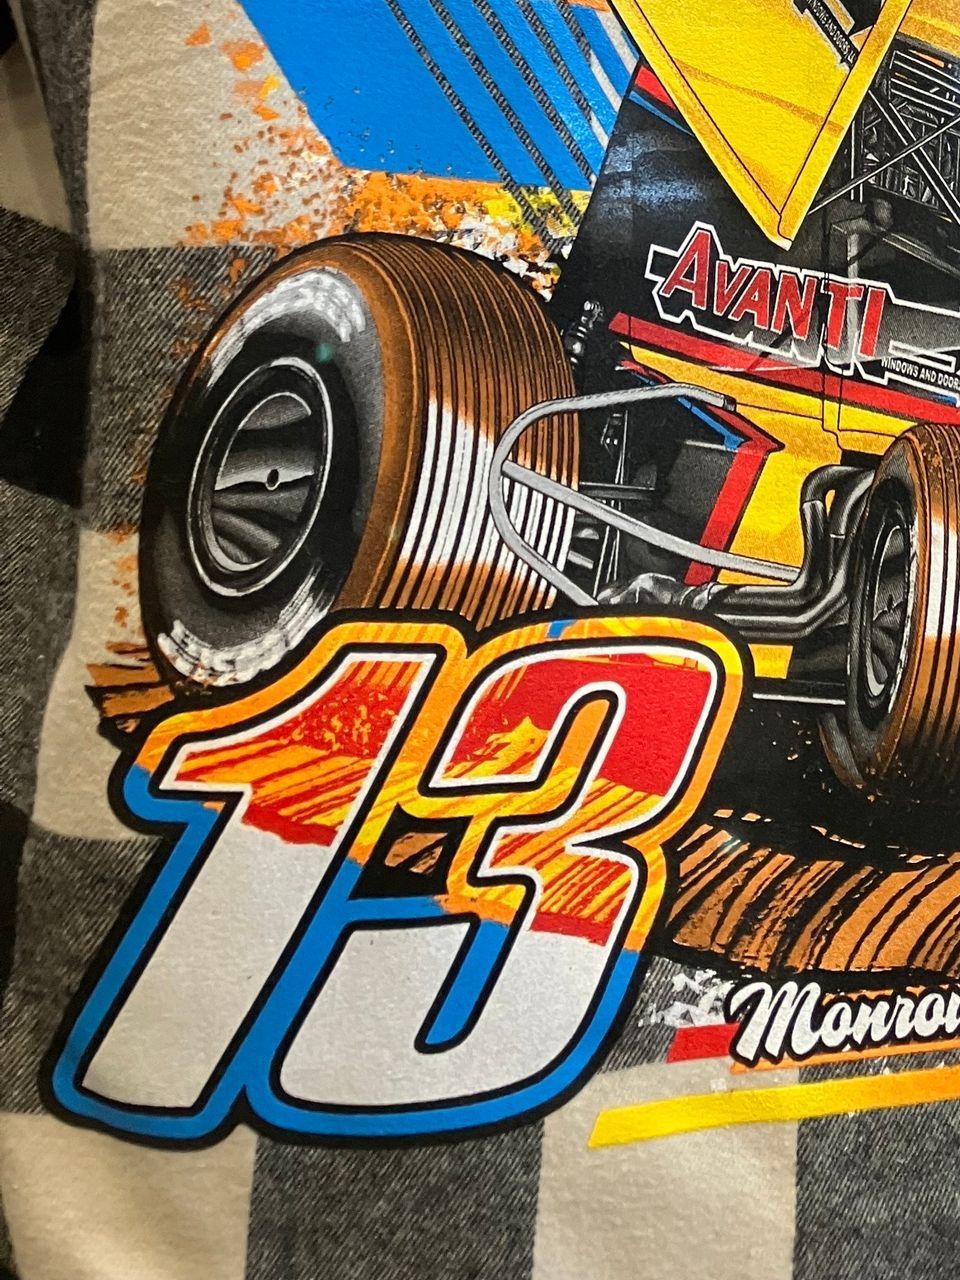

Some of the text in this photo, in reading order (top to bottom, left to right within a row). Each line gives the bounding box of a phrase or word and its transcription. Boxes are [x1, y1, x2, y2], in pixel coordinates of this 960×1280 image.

[661, 229, 888, 357] AVANTI
[881, 358, 918, 378] WINDOWS
[919, 367, 937, 383] AND
[80, 648, 728, 1110] 13
